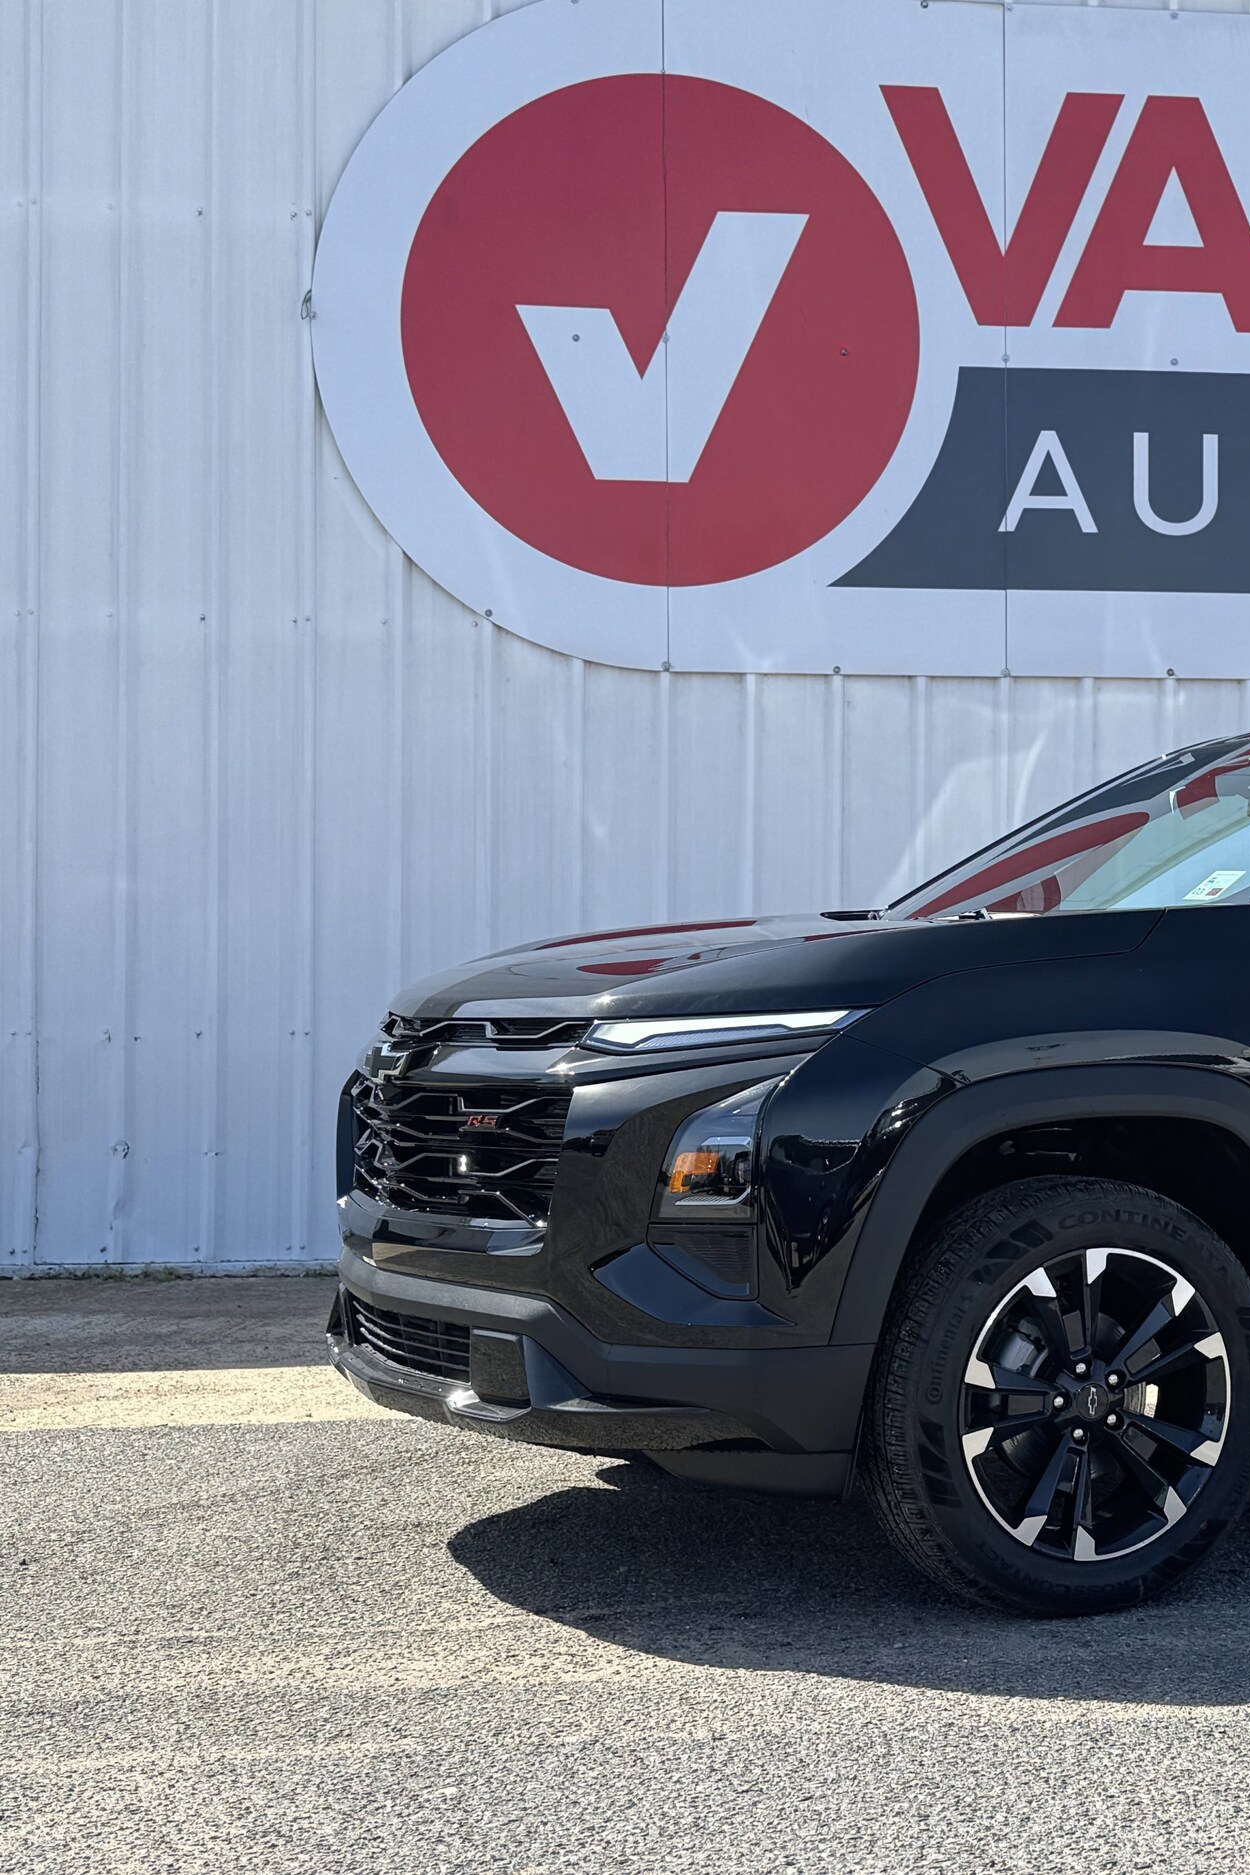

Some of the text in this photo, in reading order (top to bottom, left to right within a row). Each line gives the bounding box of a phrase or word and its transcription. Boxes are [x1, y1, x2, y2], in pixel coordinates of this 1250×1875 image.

[466, 1115, 499, 1128] RS
[1058, 1208, 1238, 1288] CONTINENTA
[925, 1306, 966, 1406] Continental
